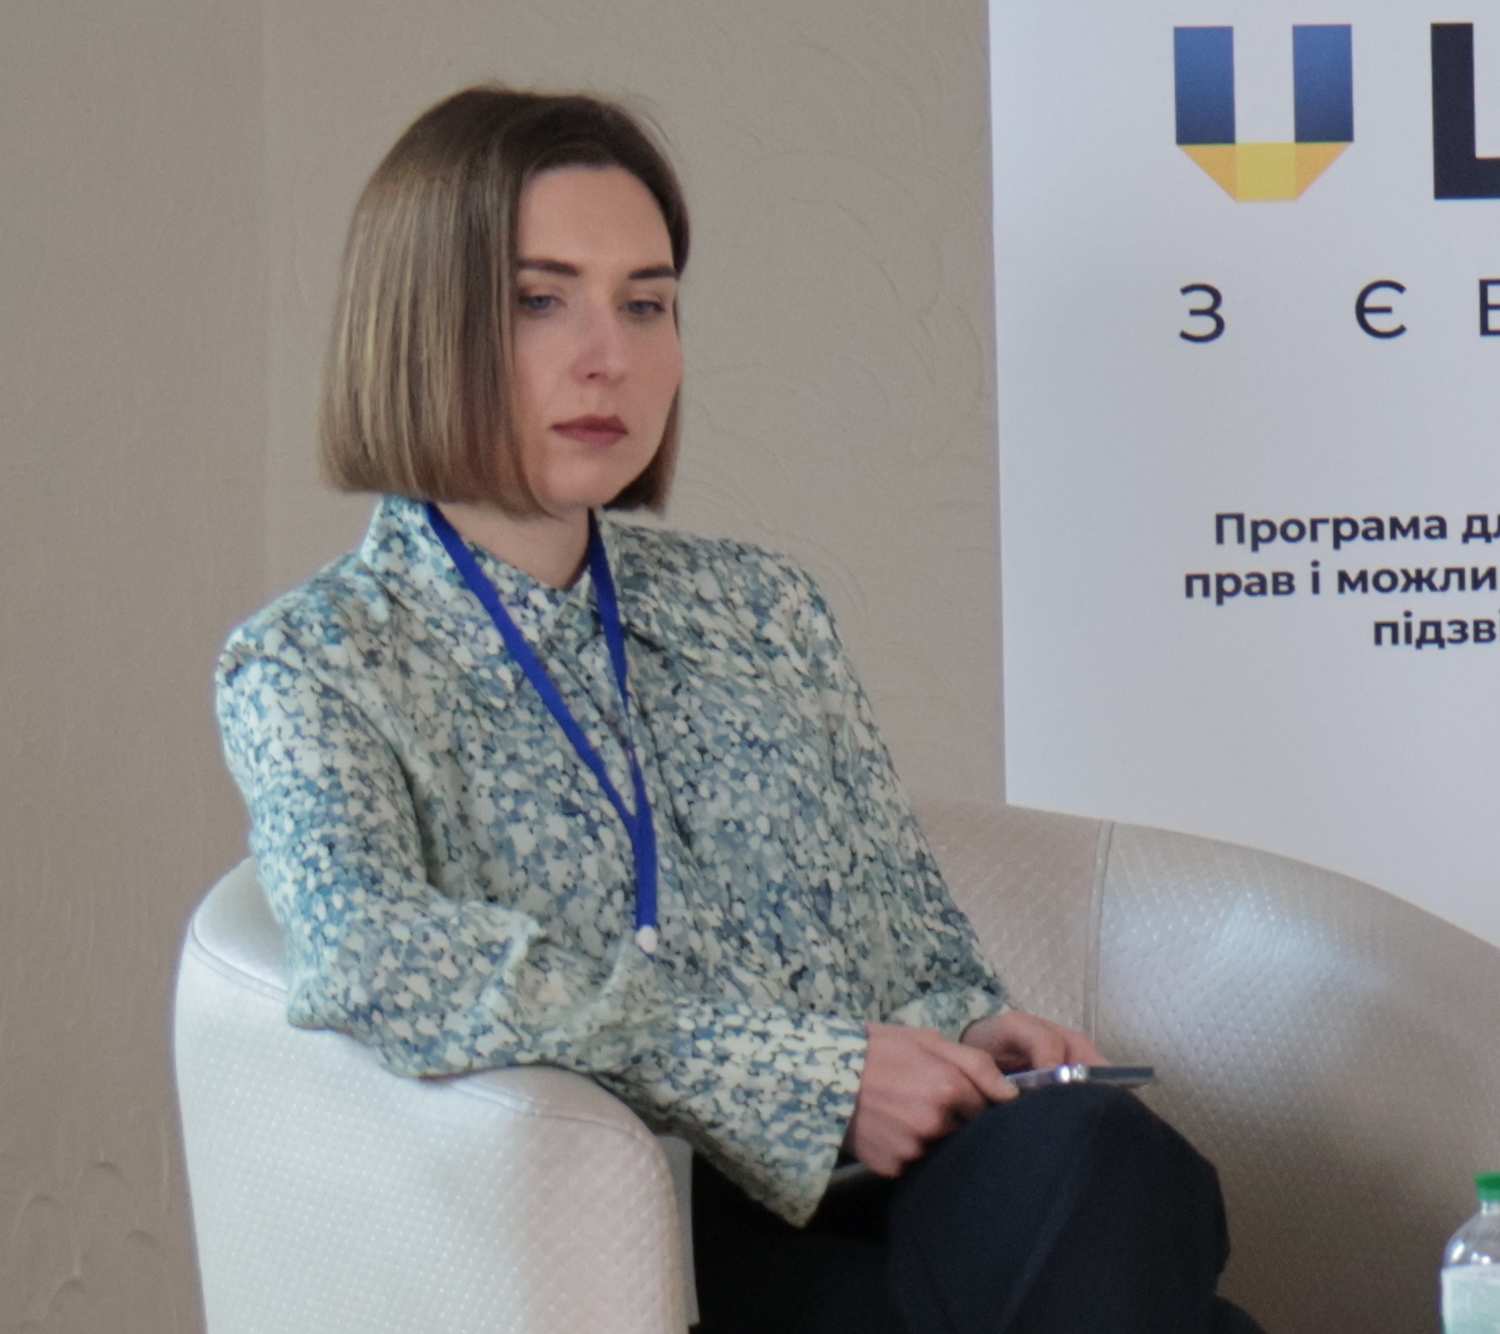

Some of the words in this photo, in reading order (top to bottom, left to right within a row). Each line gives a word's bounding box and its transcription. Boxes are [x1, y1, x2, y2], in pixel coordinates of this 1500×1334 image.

[1179, 283, 1226, 344] З
[1214, 512, 1448, 550] Програма
[1183, 571, 1296, 607] прав
[1310, 560, 1321, 596] і
